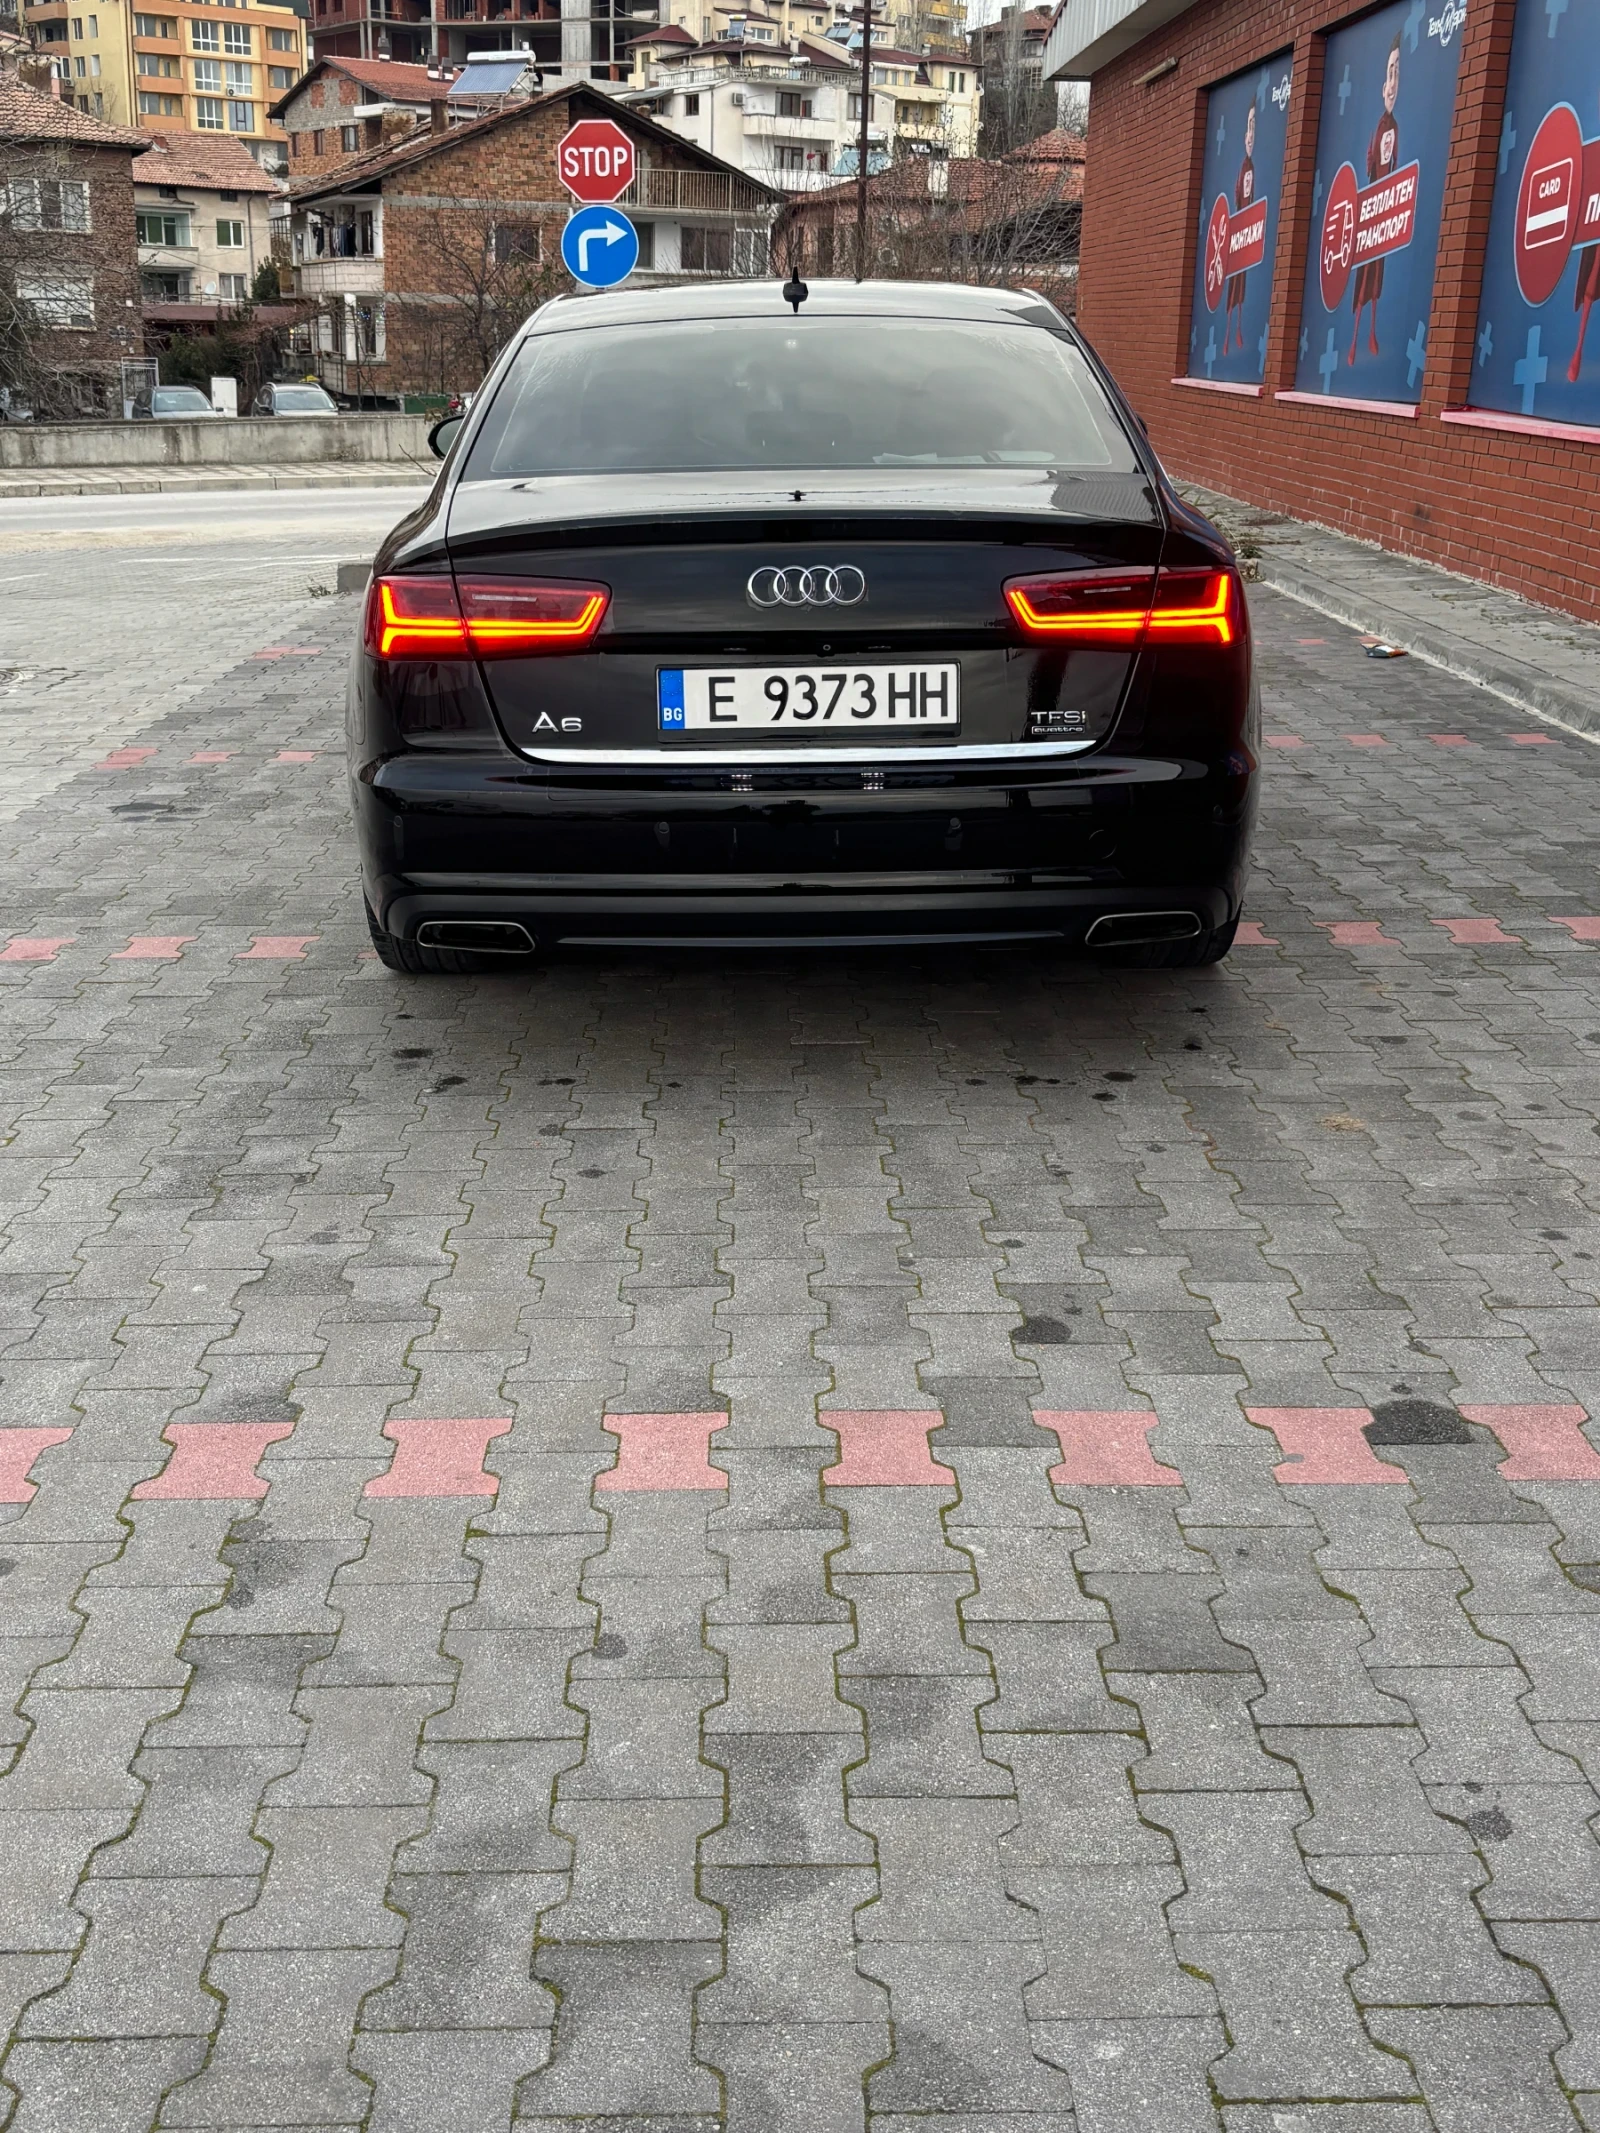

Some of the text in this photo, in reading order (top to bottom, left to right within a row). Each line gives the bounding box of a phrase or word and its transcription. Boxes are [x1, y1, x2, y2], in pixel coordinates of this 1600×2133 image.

[564, 146, 628, 178] STOP
[1359, 176, 1415, 223] БЕЗПЛАТЕН
[1539, 177, 1561, 199] CARD
[1229, 219, 1264, 254] МОНТАЖИ
[1356, 209, 1411, 254] ТРАНСПОРТ
[708, 676, 738, 722] E
[763, 674, 877, 721] 9373
[531, 711, 582, 732] A6
[663, 706, 683, 721] BG
[1030, 710, 1086, 724] TFSI
[1033, 726, 1083, 734] quattro
